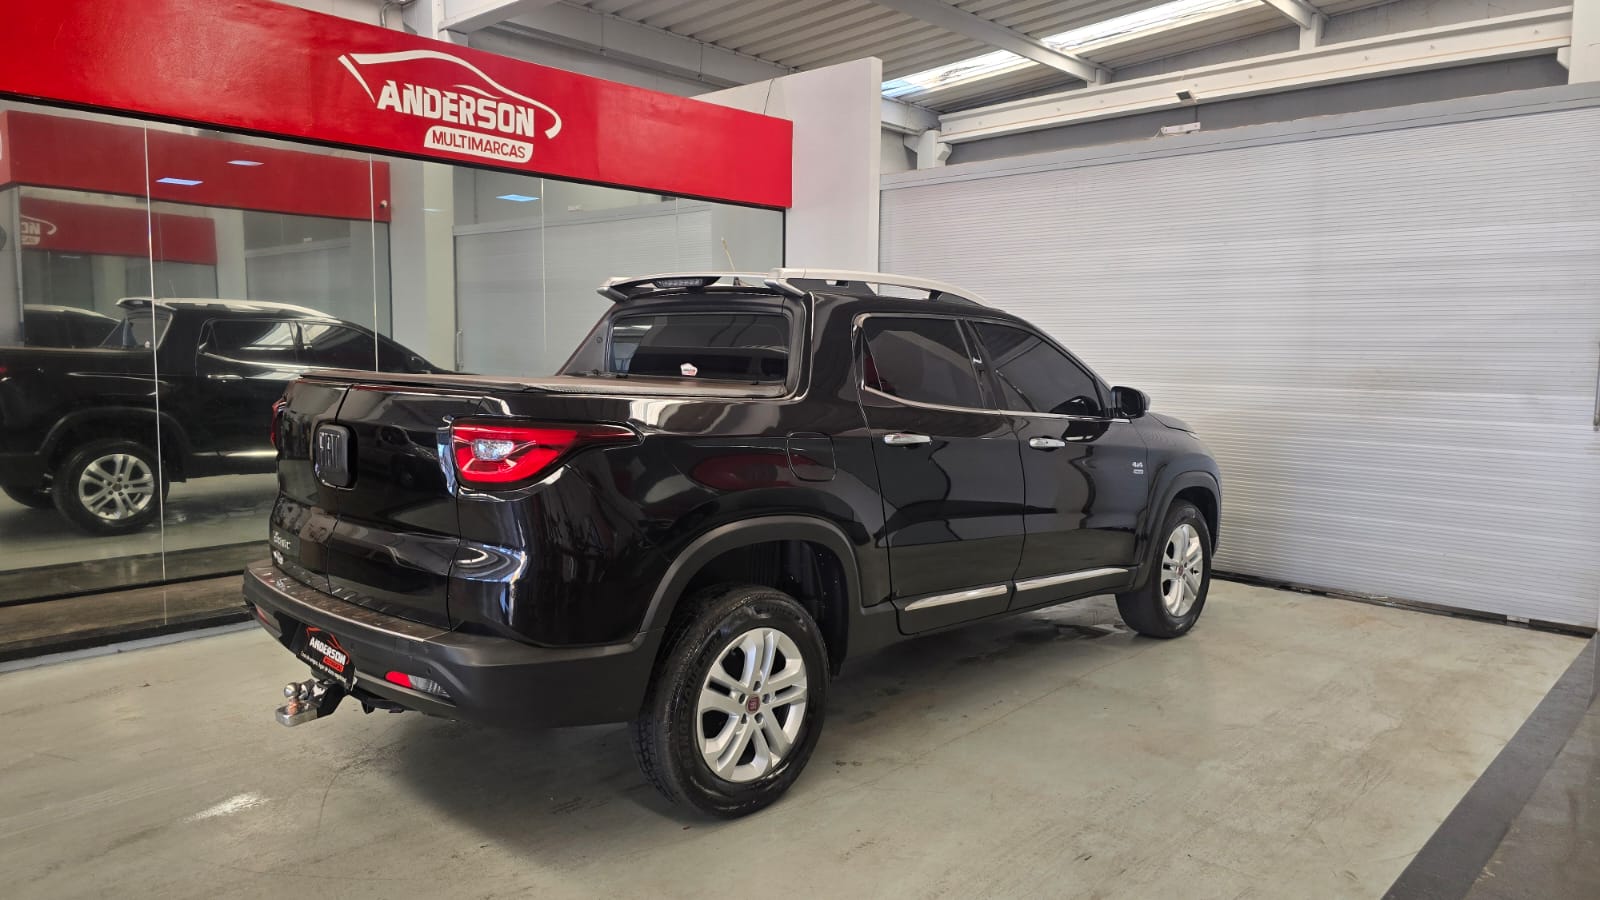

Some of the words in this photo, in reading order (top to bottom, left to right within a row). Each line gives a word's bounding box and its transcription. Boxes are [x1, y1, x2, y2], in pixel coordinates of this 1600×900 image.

[376, 79, 535, 137] ANDERSON
[432, 129, 526, 159] MULTIMARCAS
[309, 636, 347, 666] ANDERSON
